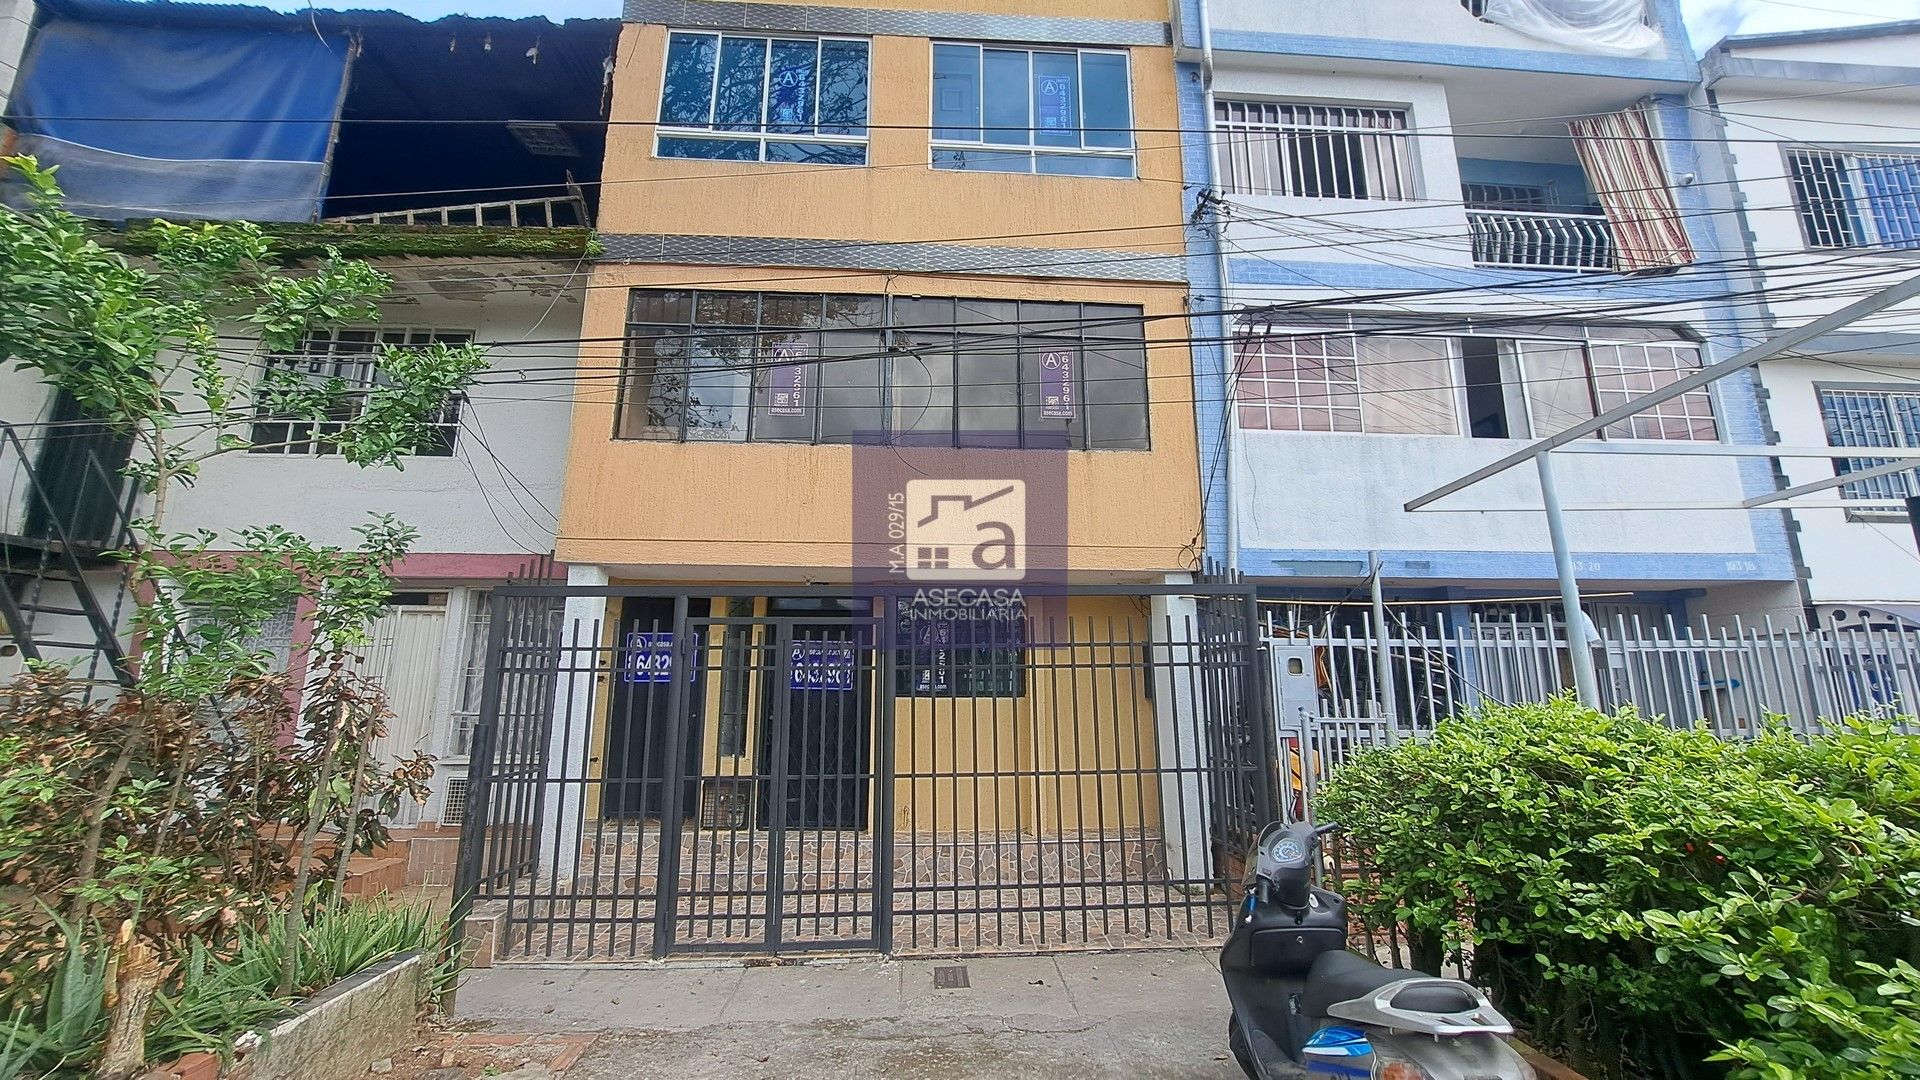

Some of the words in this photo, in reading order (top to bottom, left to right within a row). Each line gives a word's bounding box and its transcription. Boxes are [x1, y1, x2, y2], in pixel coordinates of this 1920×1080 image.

[1058, 84, 1067, 129] 6432961
[1045, 353, 1057, 366] A
[1061, 355, 1071, 410] 6432961
